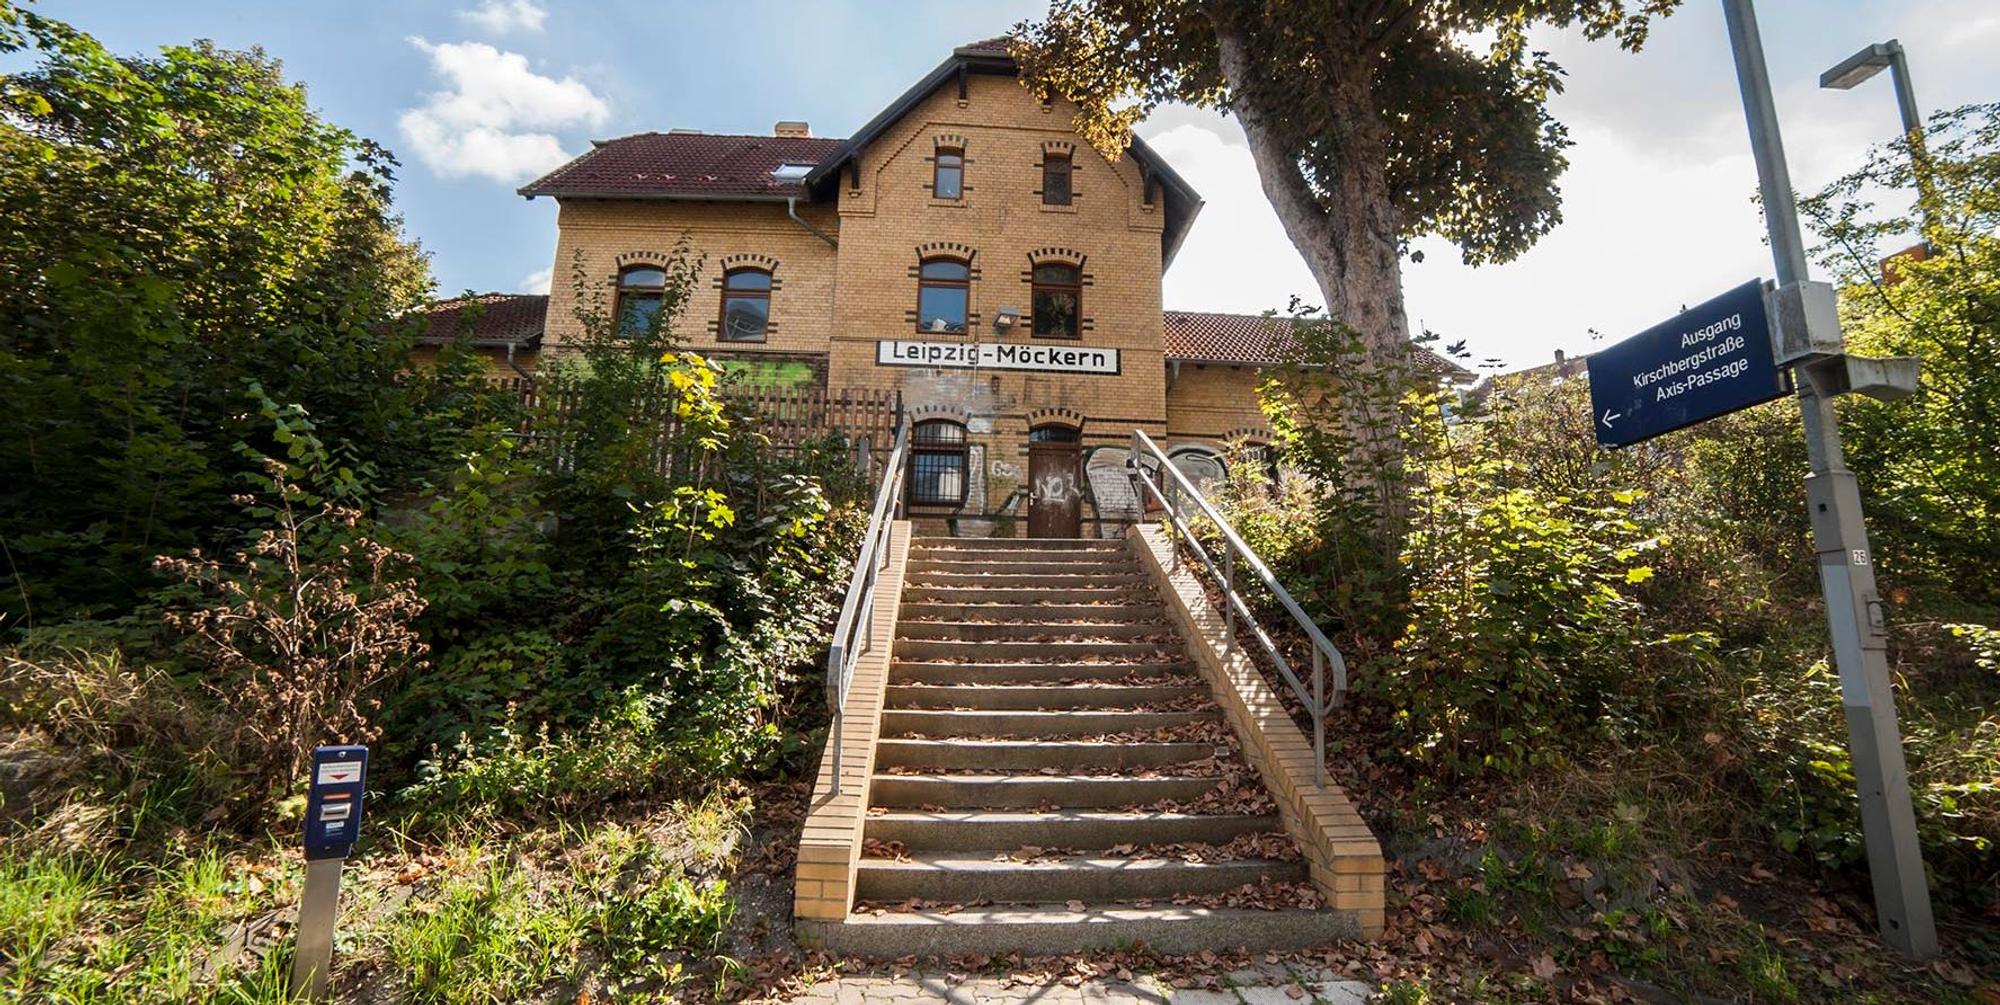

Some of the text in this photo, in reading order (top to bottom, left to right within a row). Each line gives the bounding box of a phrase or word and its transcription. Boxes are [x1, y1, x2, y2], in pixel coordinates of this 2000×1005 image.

[1681, 312, 1741, 348] Ausgang
[893, 341, 1105, 367] Leipzig-Möckern
[1633, 335, 1745, 387] Kirschbergstraße
[1656, 358, 1749, 401] Axis-Passage
